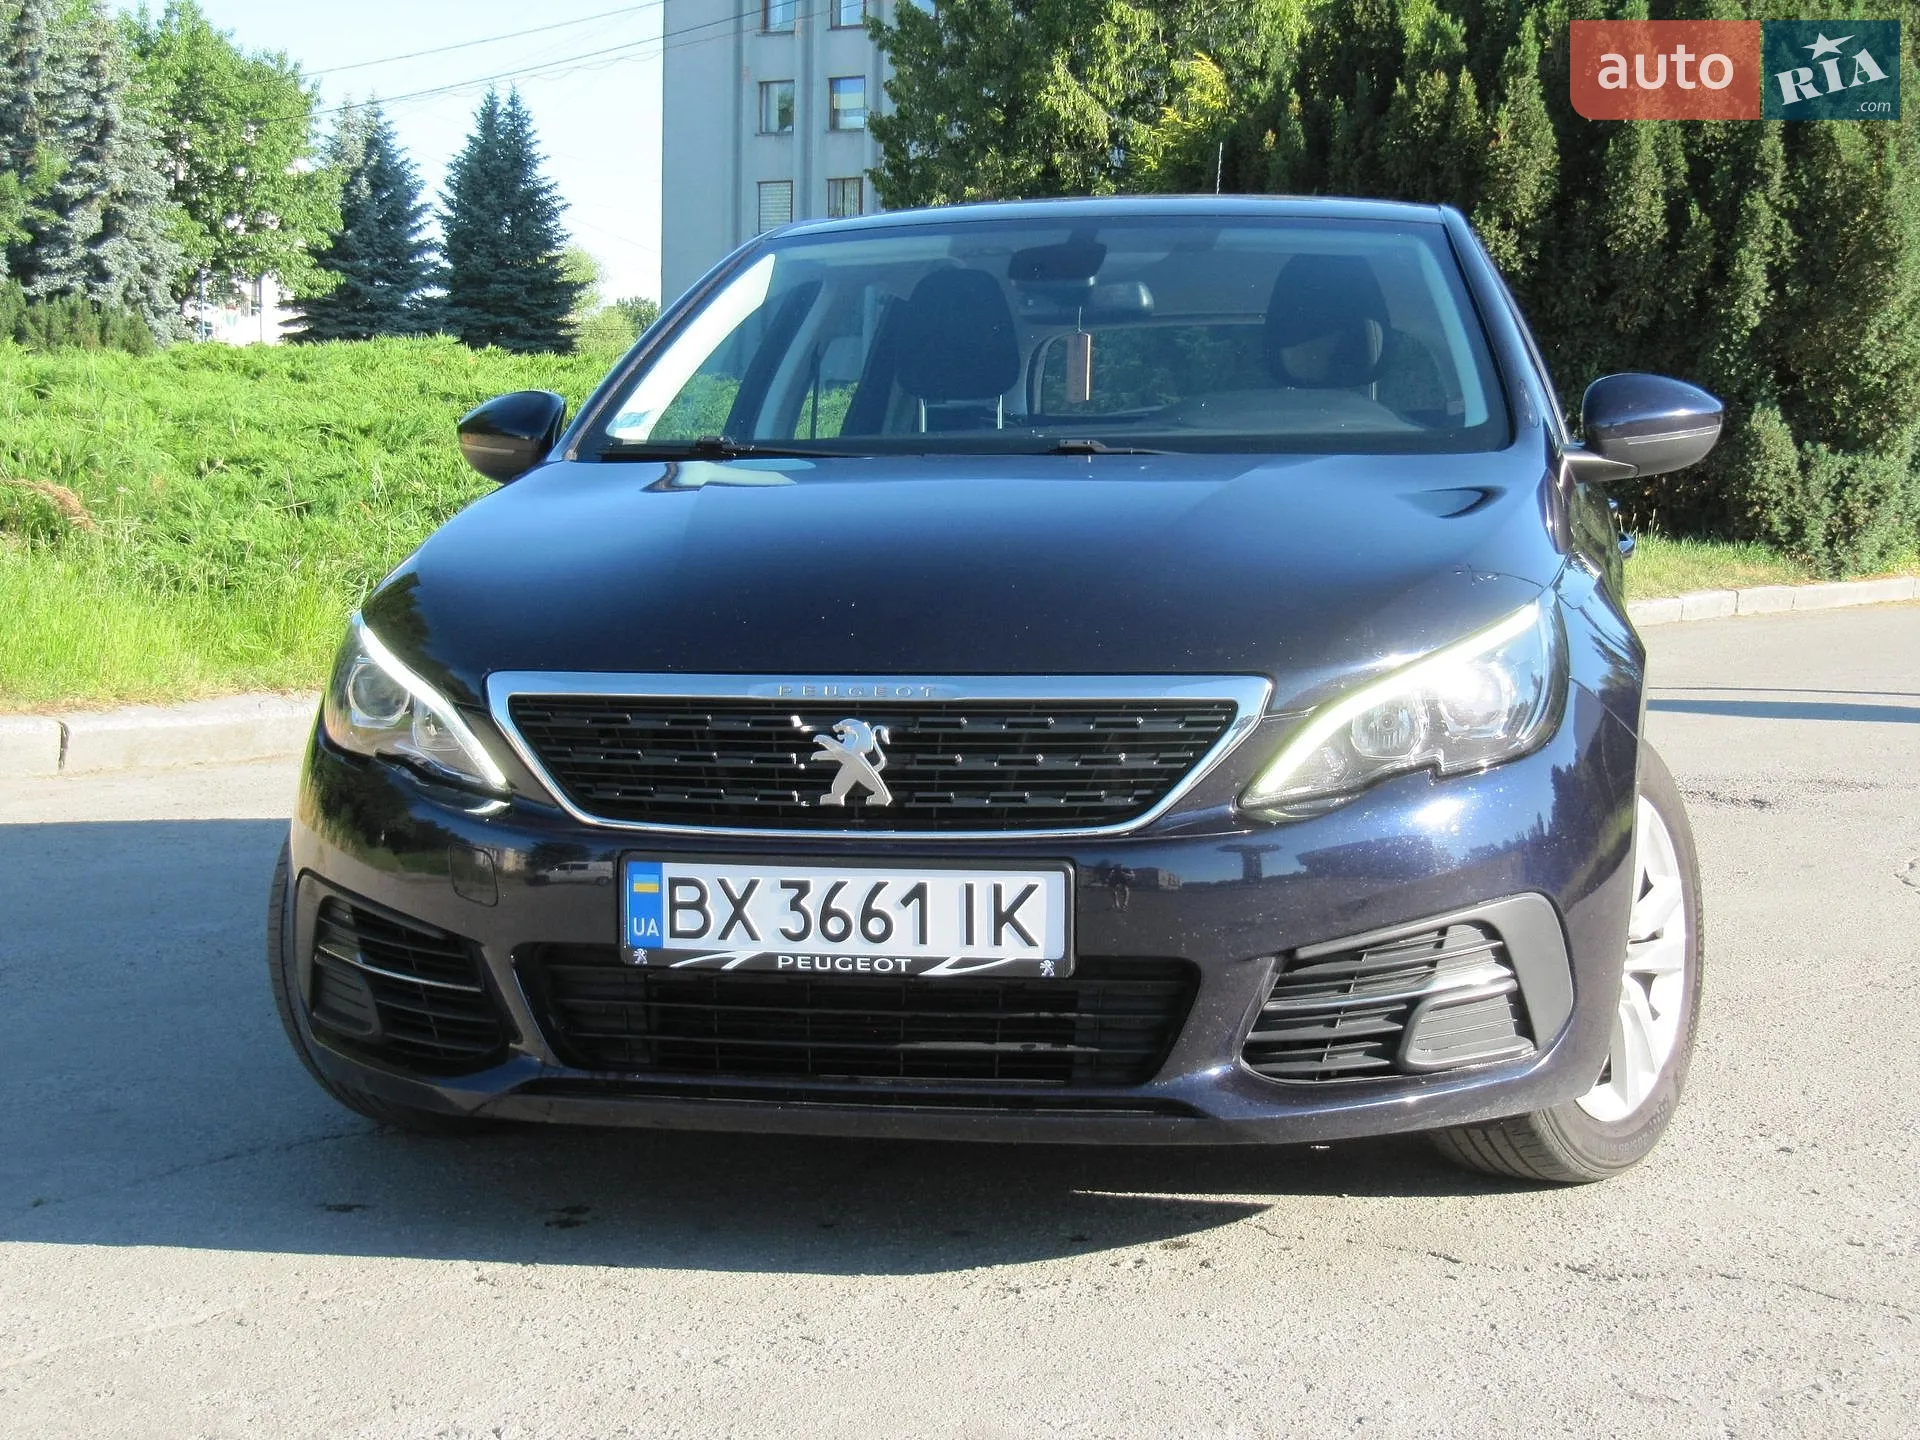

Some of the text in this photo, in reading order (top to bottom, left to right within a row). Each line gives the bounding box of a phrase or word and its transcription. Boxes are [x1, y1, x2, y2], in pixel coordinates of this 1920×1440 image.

[778, 684, 936, 697] PEUGEOT
[668, 877, 1040, 948] BX 3661 IK
[633, 917, 660, 937] UA
[777, 955, 912, 973] PEUGEOT
